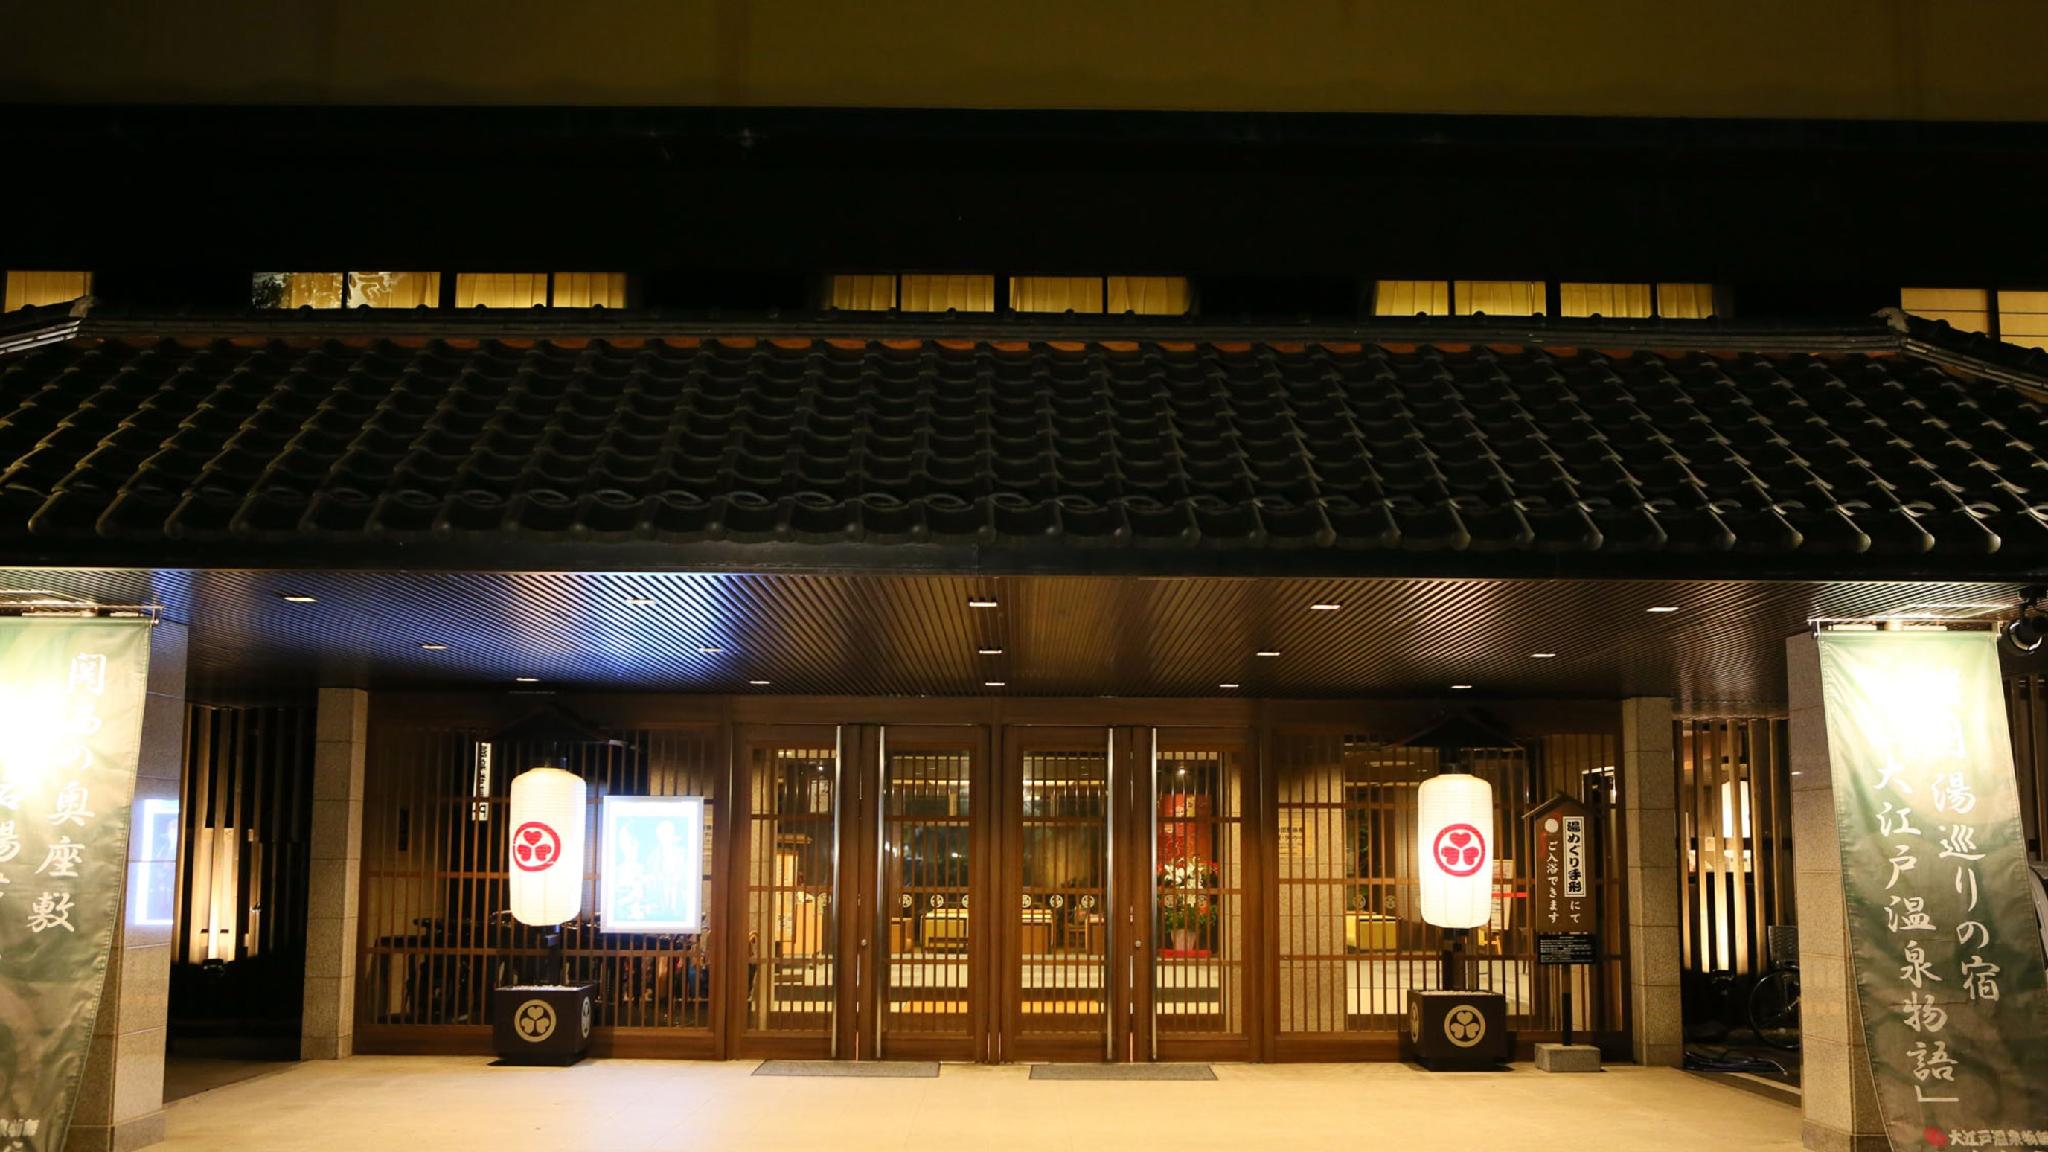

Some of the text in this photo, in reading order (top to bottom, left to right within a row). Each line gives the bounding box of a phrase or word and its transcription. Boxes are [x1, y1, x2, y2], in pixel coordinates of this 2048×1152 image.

[1546, 841, 1559, 924] ご入浴できます
